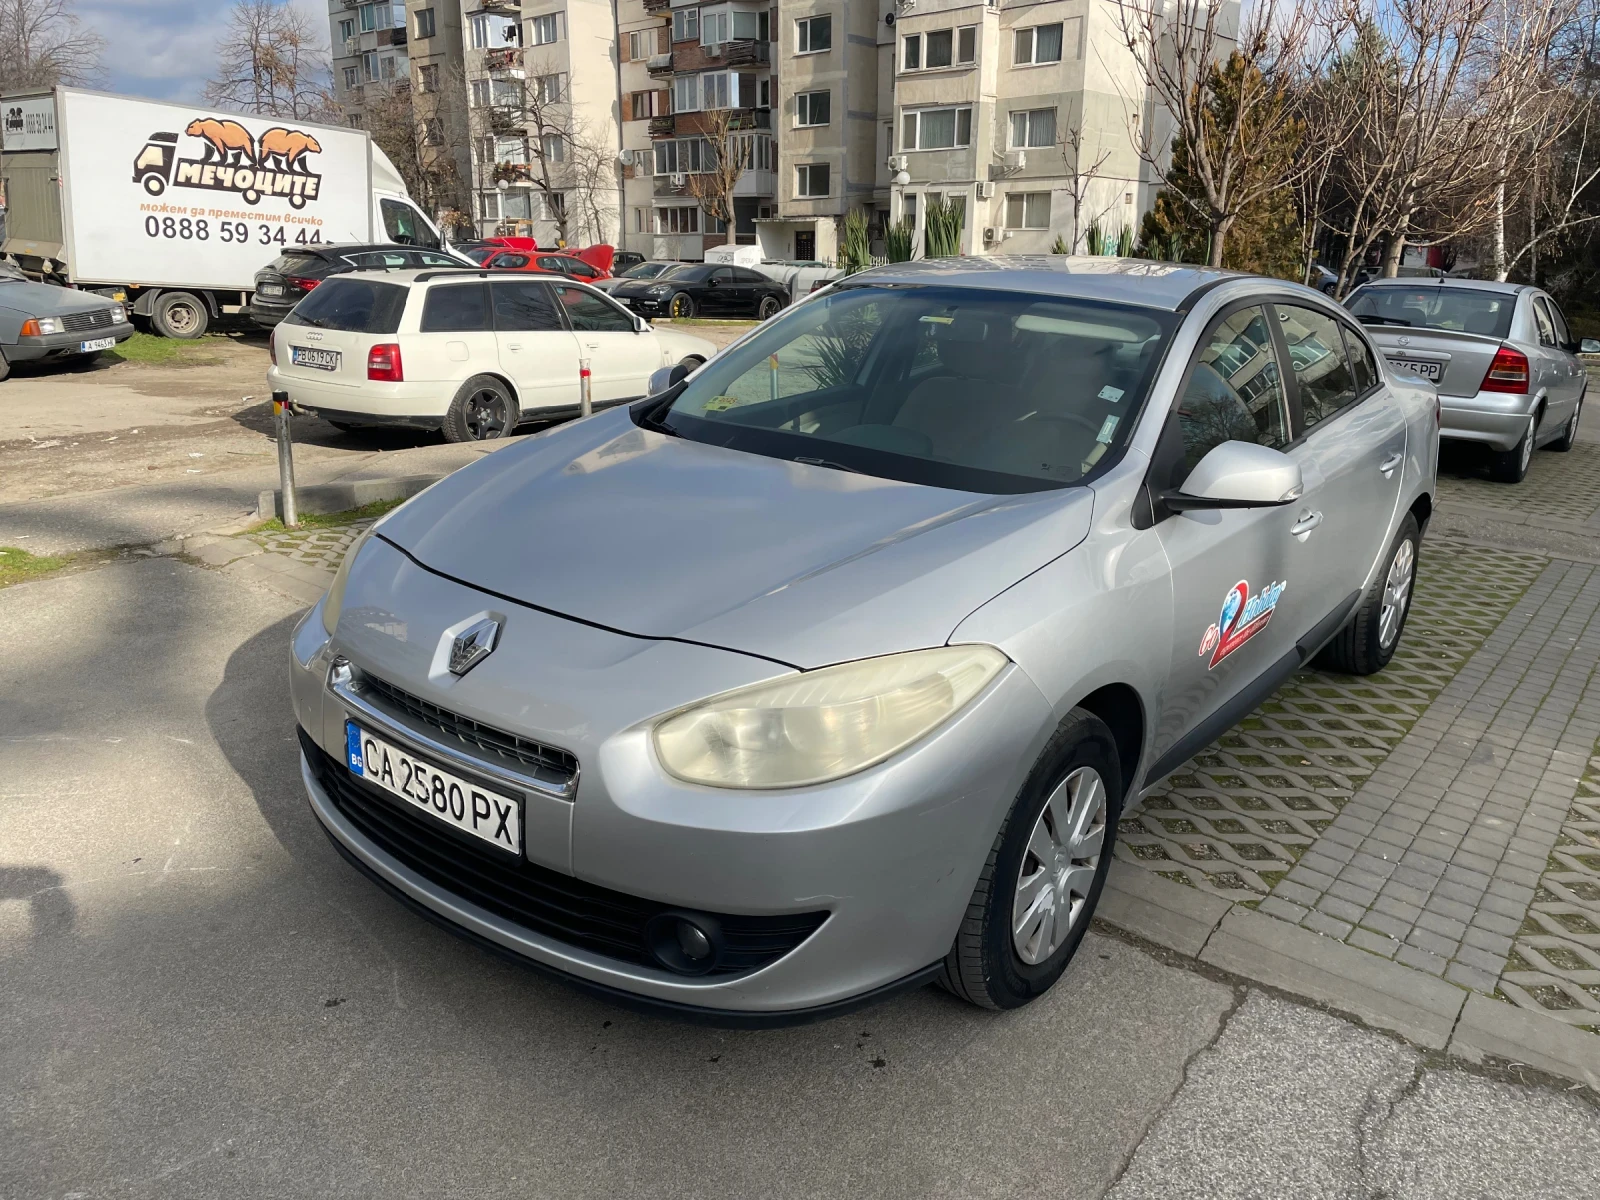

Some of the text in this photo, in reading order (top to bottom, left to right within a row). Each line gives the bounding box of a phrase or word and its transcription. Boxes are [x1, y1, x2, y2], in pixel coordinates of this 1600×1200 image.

[177, 162, 318, 196] МЕЧОЦИТЕ
[140, 203, 323, 226] можем да преместим всичко
[145, 215, 322, 246] 0888 59 34 44
[352, 753, 363, 767] BG
[364, 739, 513, 845] CA 2580 PX
